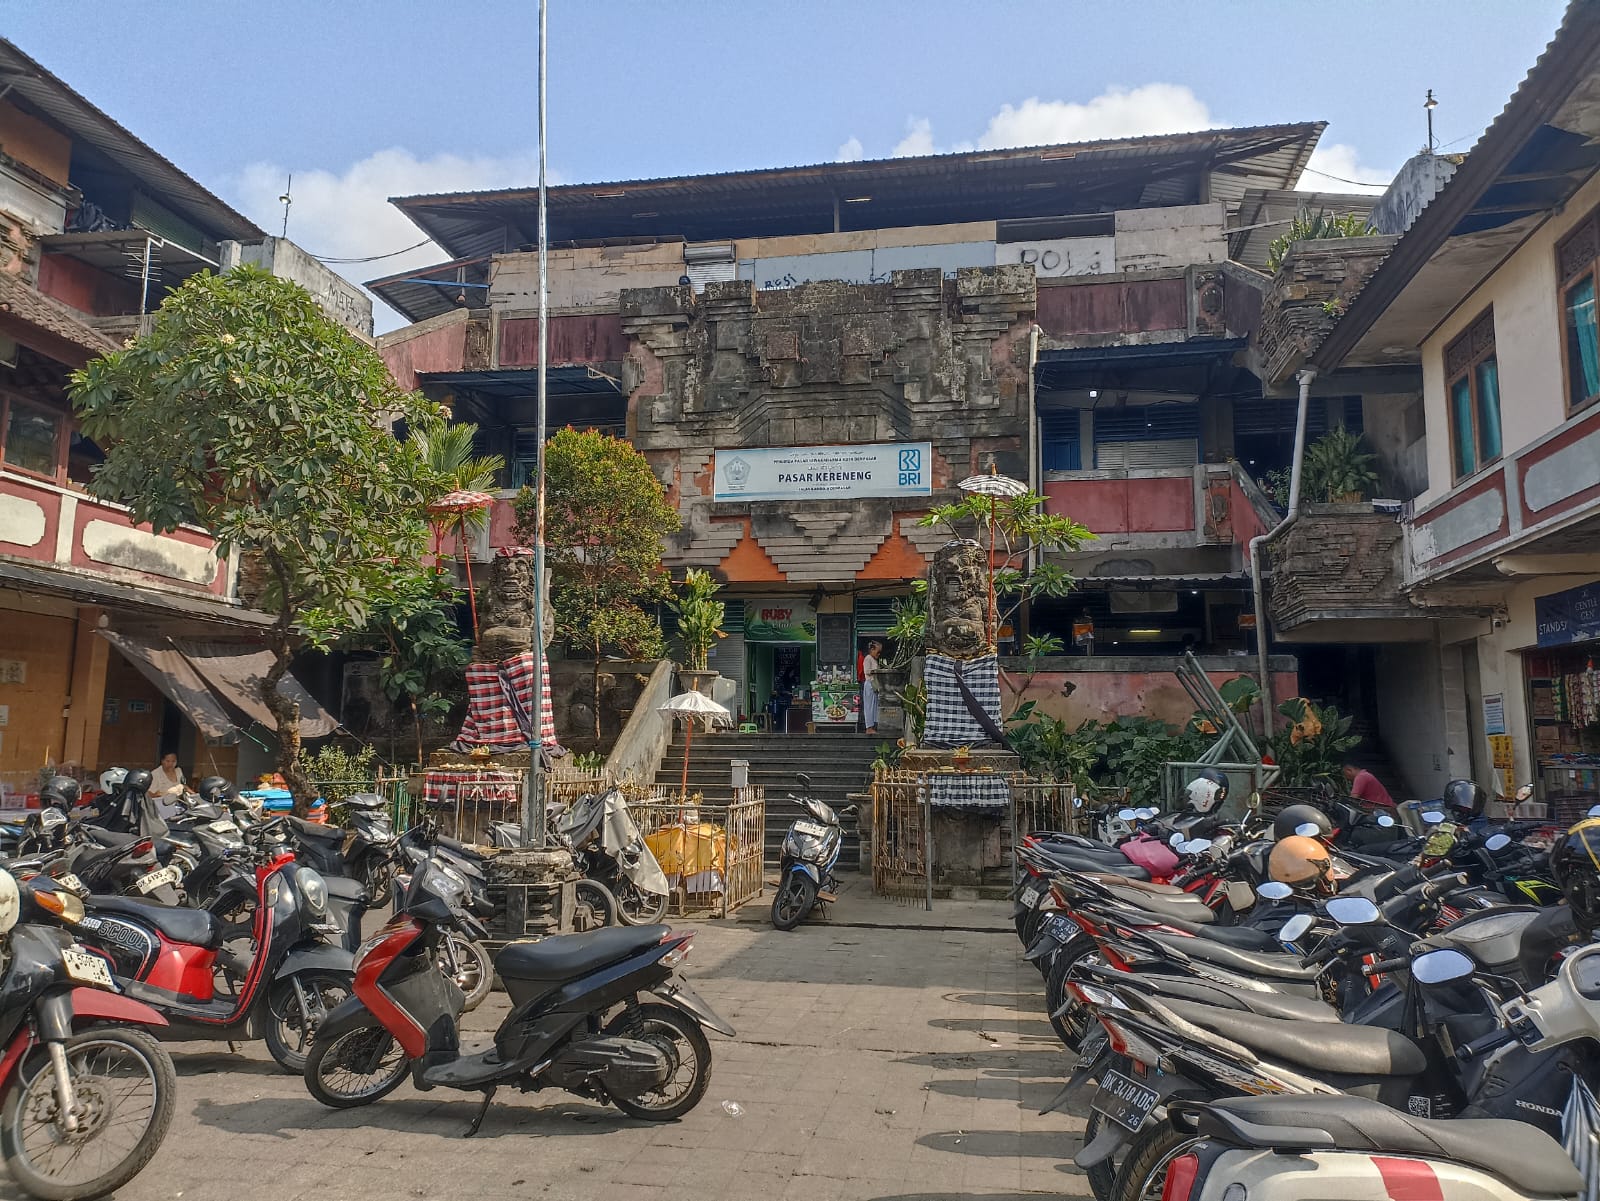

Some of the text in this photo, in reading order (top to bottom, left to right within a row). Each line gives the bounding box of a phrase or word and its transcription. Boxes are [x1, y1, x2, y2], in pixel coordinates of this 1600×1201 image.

[778, 471, 872, 483] PASAR KERENENG
[898, 472, 921, 486] BRI
[761, 608, 793, 621] RUBY
[1102, 1073, 1155, 1111] DK 3418 ADG
[1515, 1099, 1563, 1118] HONDA
